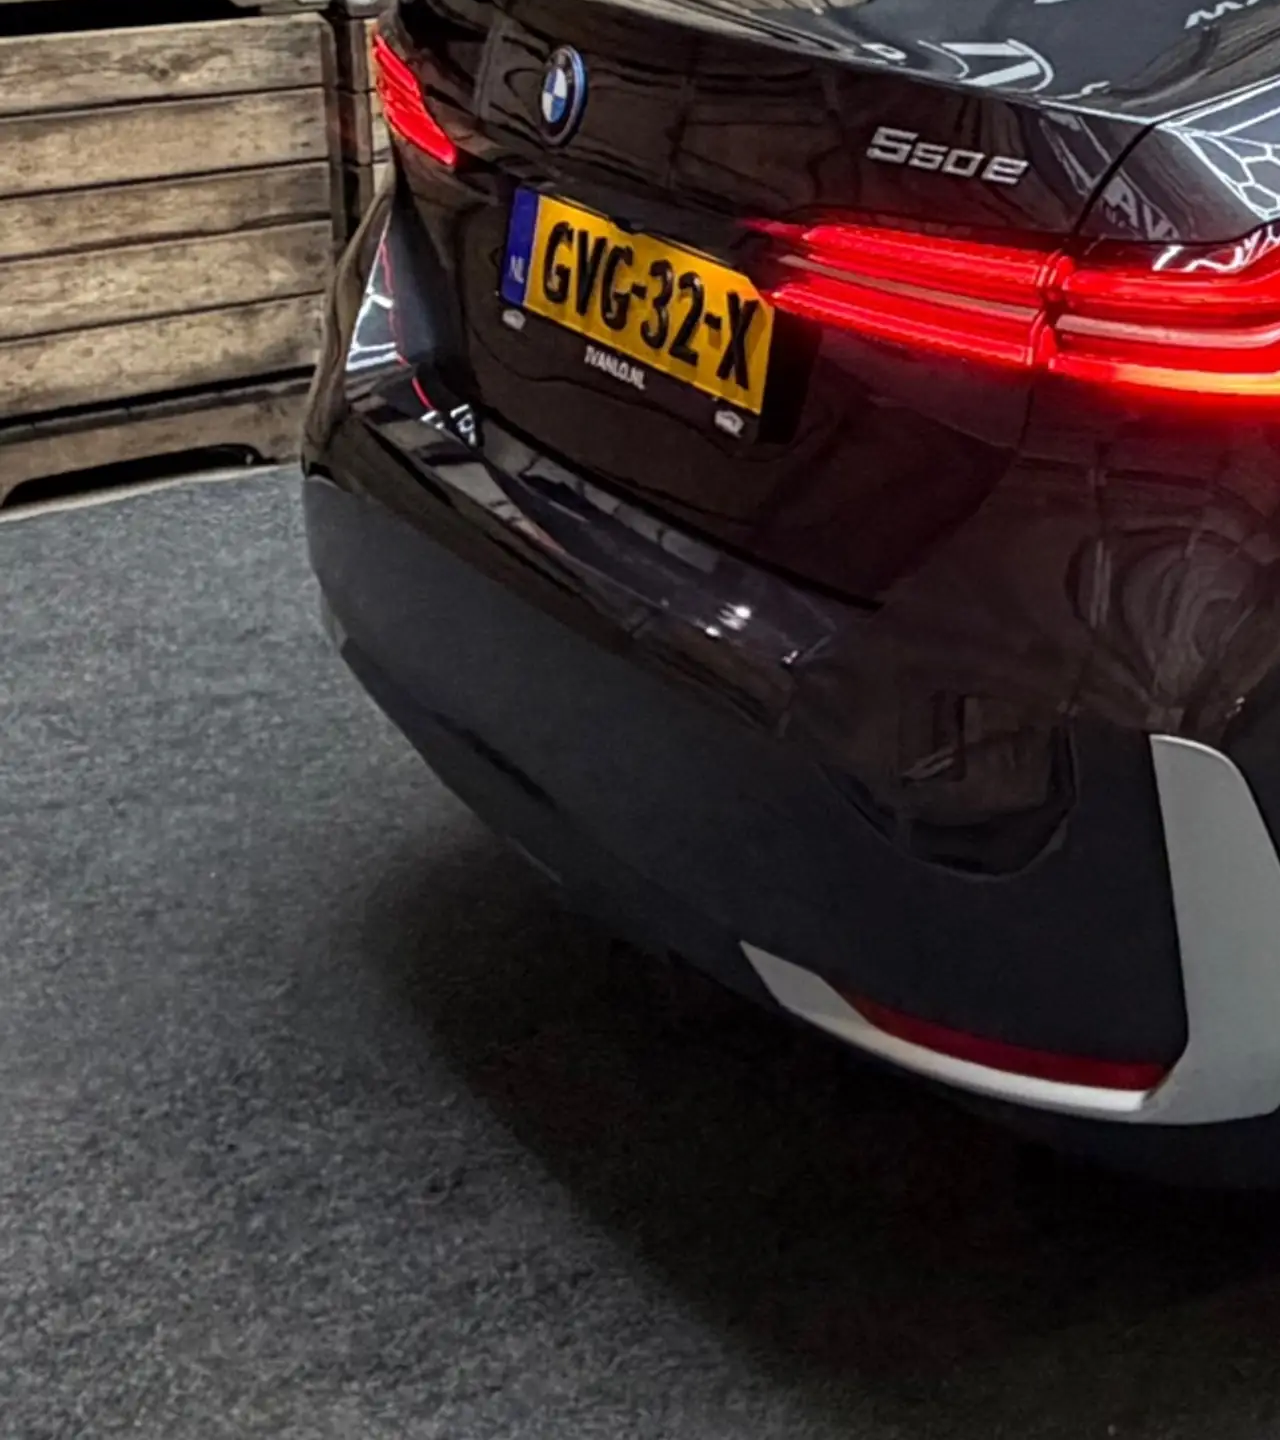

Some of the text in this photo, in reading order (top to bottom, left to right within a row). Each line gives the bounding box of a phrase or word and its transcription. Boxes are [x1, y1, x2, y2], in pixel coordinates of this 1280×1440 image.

[509, 255, 525, 284] NL
[541, 220, 759, 391] GVG-32-X
[583, 344, 646, 391] IVANLO.NL
